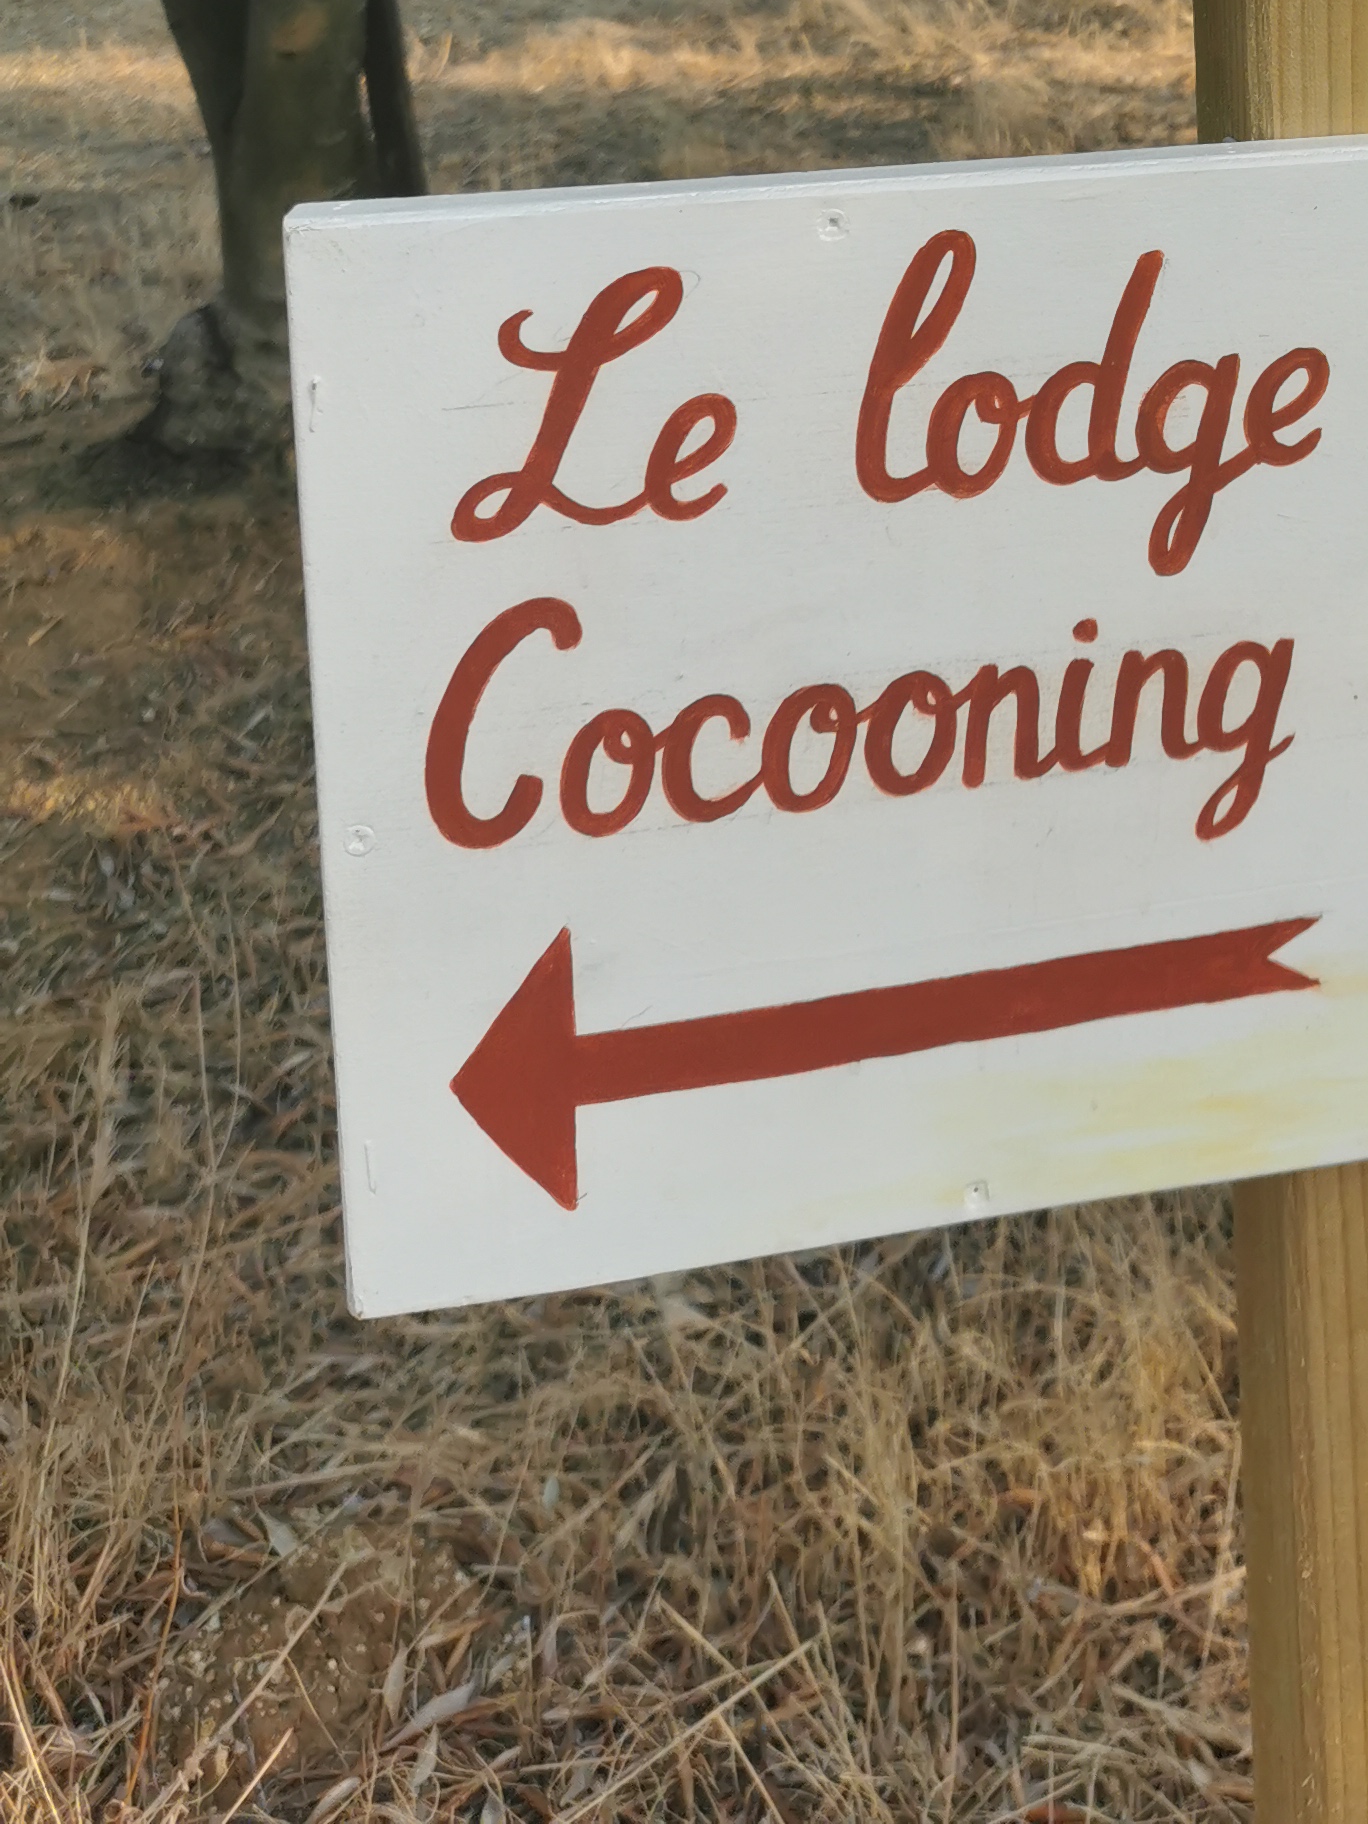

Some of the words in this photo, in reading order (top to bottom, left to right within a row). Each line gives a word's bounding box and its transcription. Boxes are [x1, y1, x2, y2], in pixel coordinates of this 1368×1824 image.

[450, 265, 738, 545] Le
[854, 228, 1331, 576] lodge
[423, 596, 1296, 851] Cocooning
